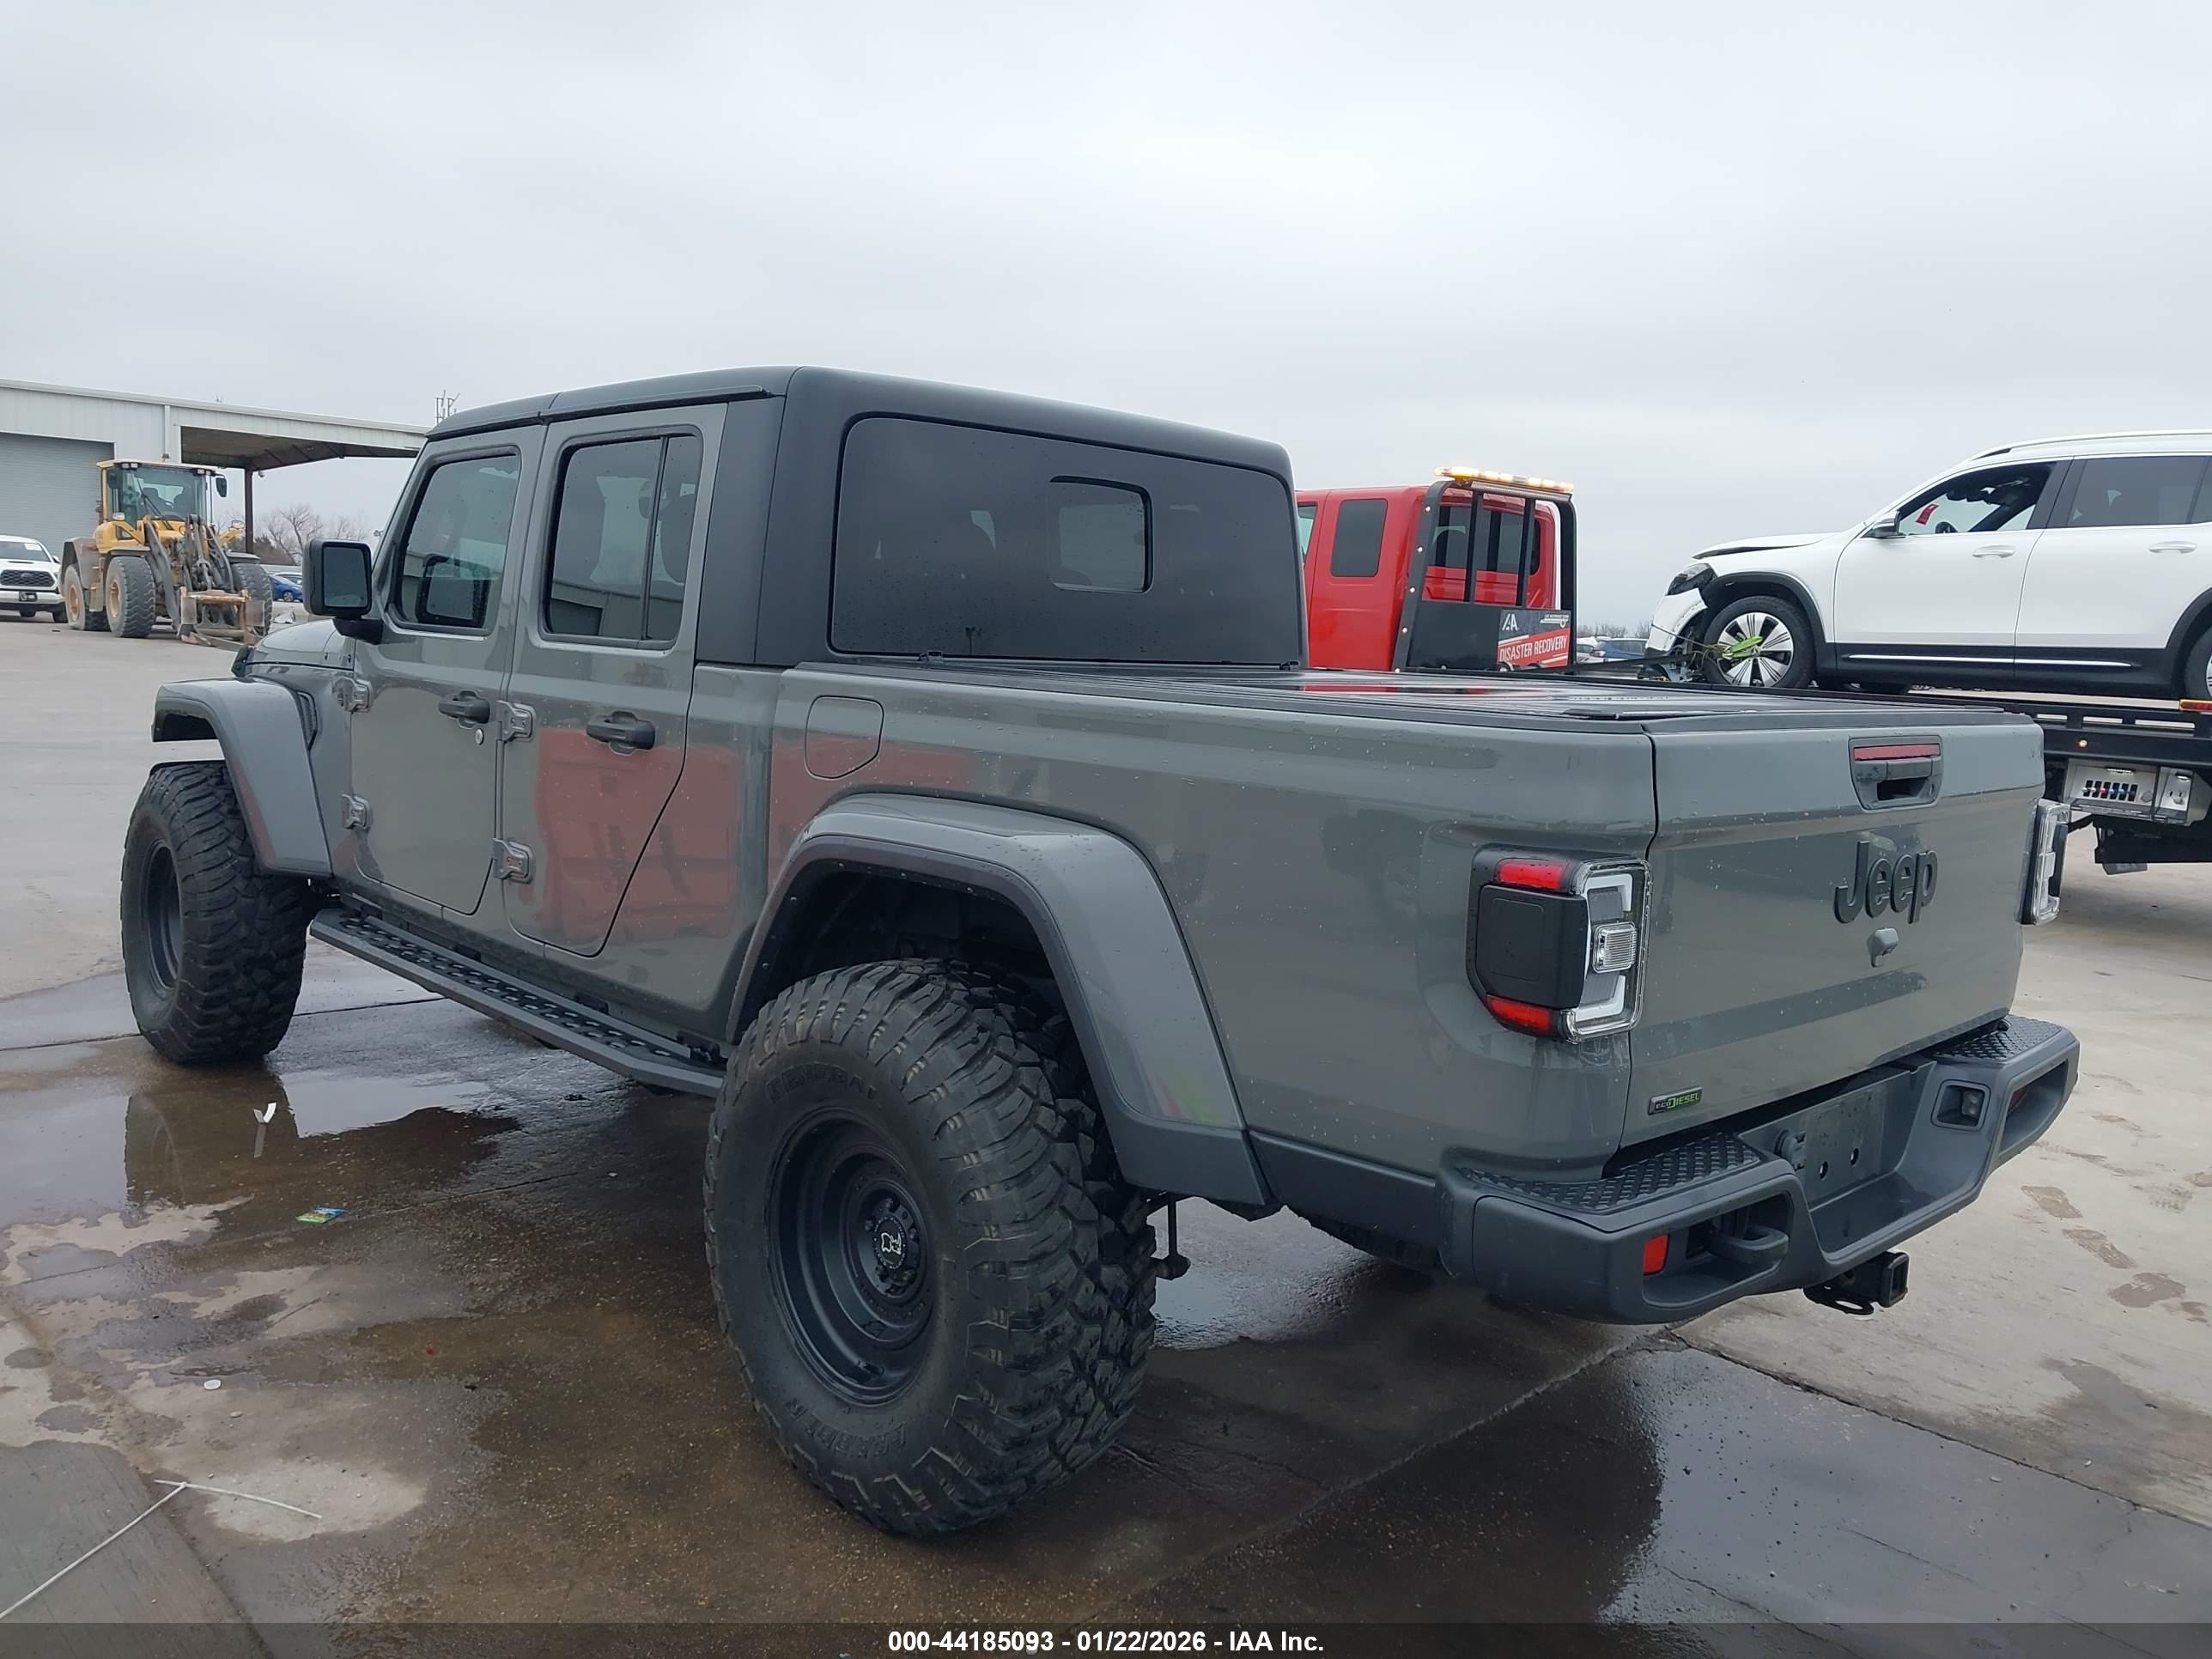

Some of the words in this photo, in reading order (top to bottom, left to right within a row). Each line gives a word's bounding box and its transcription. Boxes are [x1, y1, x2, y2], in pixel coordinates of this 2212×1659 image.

[1499, 642, 1533, 662] DISASTER
[1534, 635, 1568, 655] RECOVERY
[1834, 841, 1938, 924] Jeep
